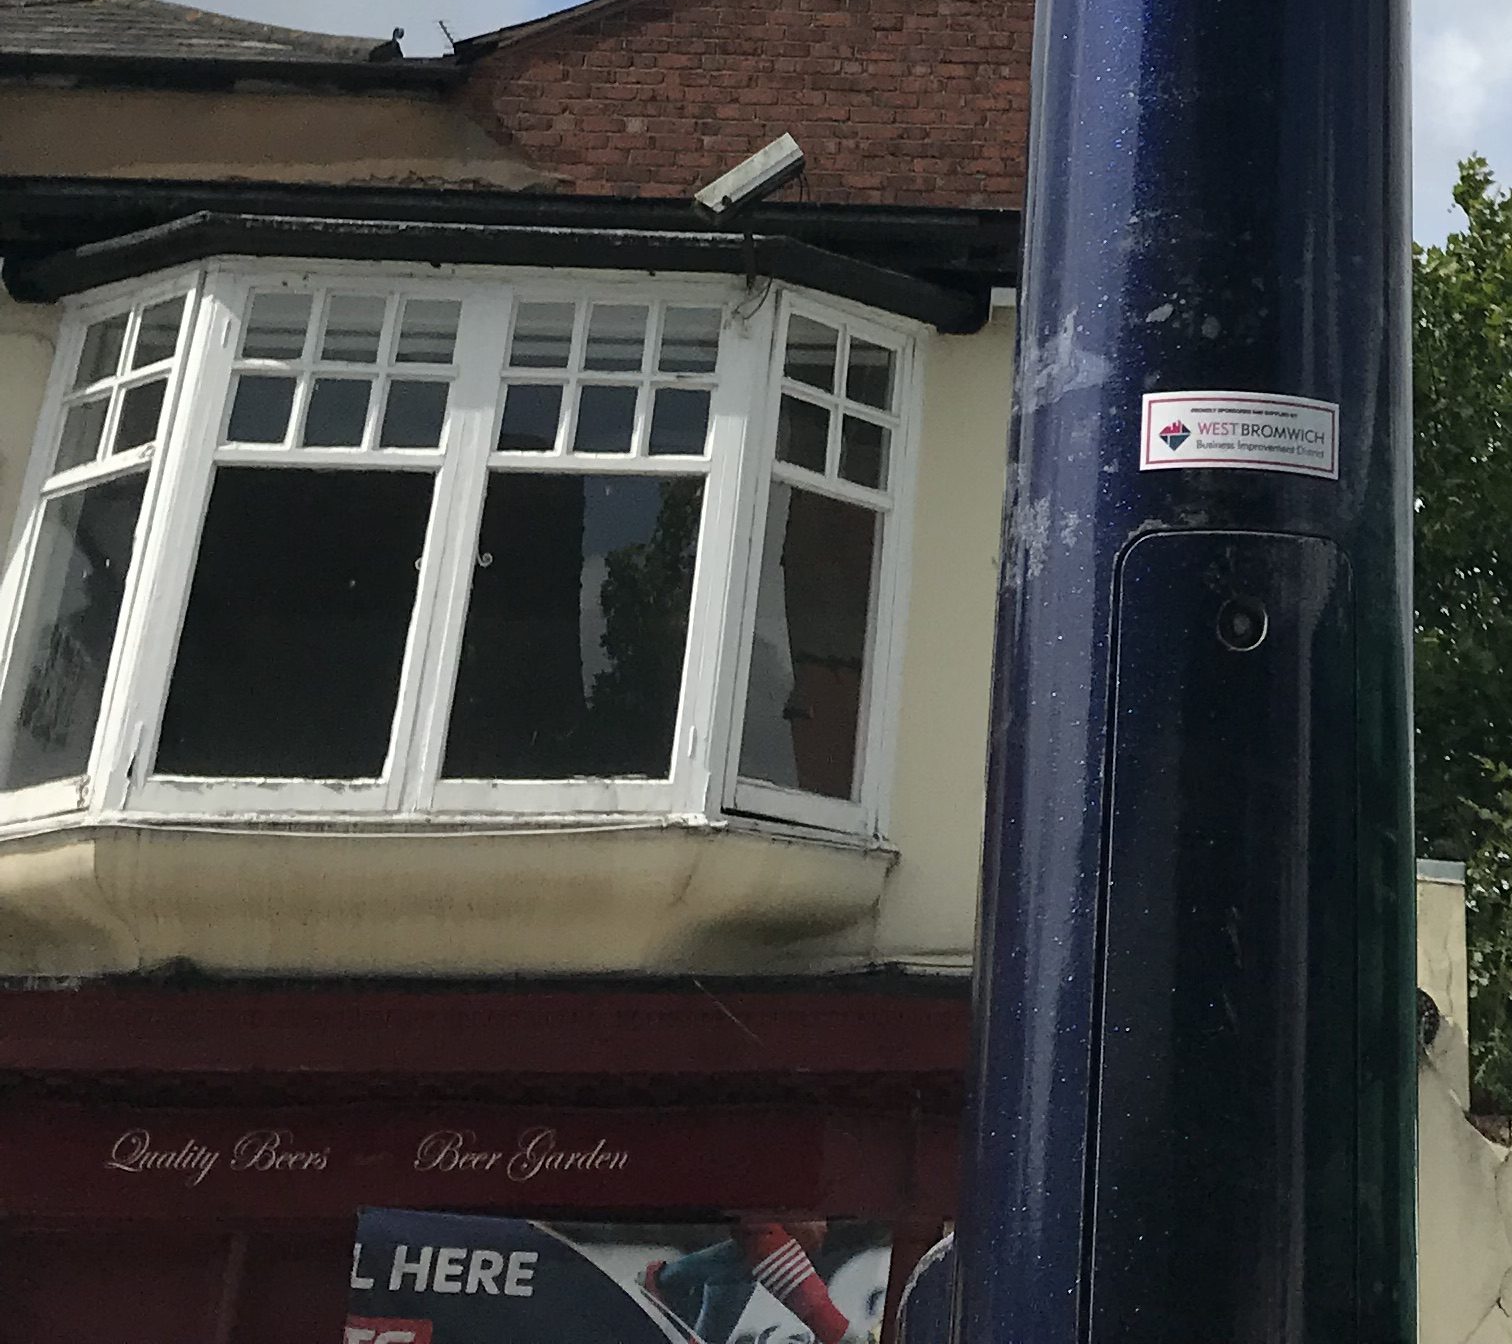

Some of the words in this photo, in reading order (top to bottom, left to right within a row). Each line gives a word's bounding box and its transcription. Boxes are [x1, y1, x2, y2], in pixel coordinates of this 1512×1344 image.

[1196, 439, 1235, 450] Business
[1238, 440, 1296, 454] Improvement
[1241, 423, 1325, 445] BROMWICH
[104, 1128, 219, 1187] Quality
[230, 1129, 330, 1172] Beers
[414, 1129, 503, 1172] Beer
[507, 1127, 630, 1182] Garden
[388, 1244, 539, 1298] HERE
